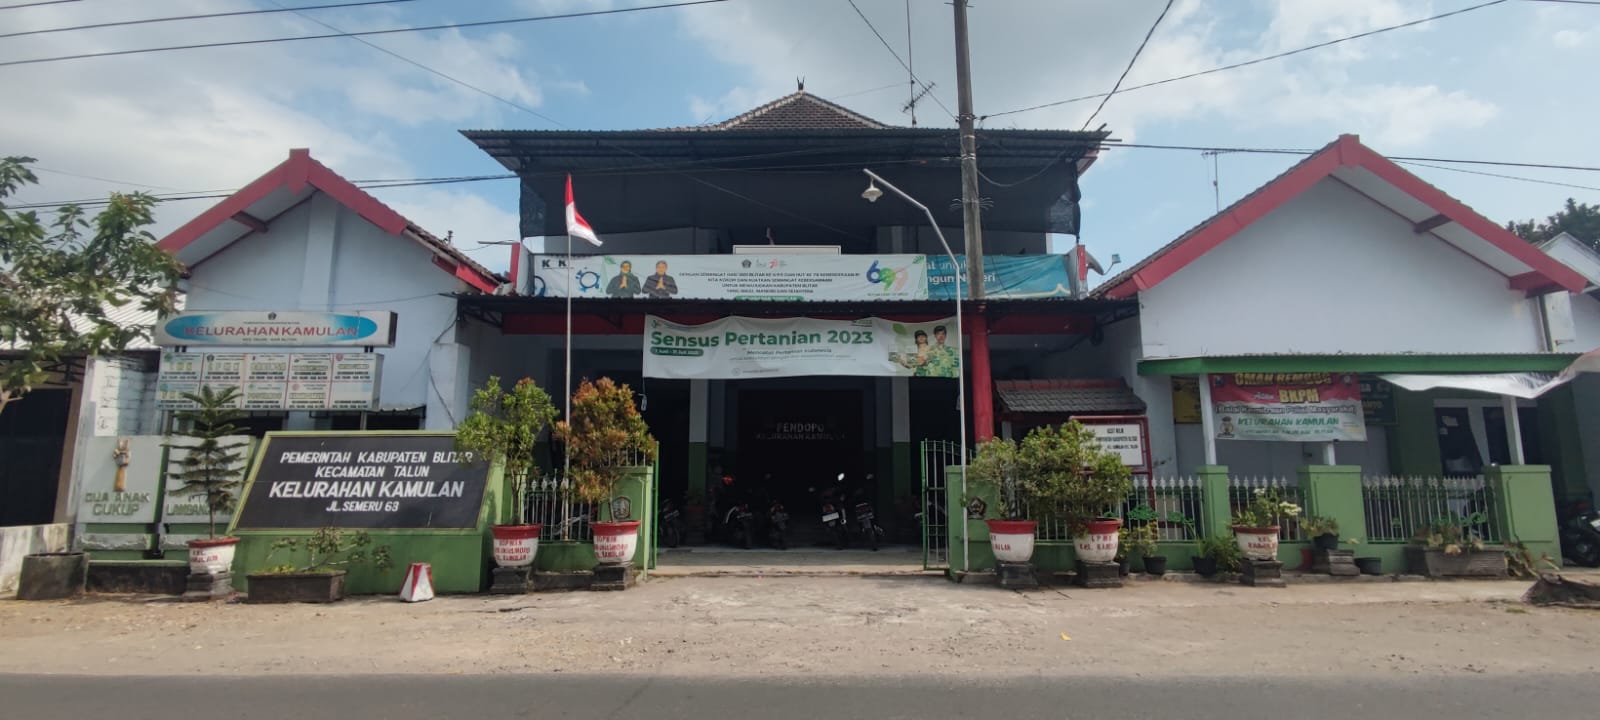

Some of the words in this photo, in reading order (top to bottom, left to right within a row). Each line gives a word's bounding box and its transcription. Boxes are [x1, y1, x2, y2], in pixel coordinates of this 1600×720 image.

[184, 326, 279, 336] KELURAHAN
[281, 327, 358, 336] KAMULAN
[651, 331, 719, 347] Sensus
[725, 330, 821, 346] Pertanian
[827, 330, 874, 345] 2023
[1279, 388, 1320, 403] BKPM
[776, 423, 825, 433] PENDOPO
[280, 451, 352, 463] PEMERINTAH
[356, 451, 427, 463] KABUPATEN
[314, 466, 384, 478] KECAMATAN
[393, 466, 430, 477] TALUN
[268, 481, 375, 498] KELURAHAN
[378, 481, 465, 498] KAMULAN
[85, 492, 109, 503] DUA
[115, 492, 151, 503] ANAK
[92, 503, 140, 516] CUKUP
